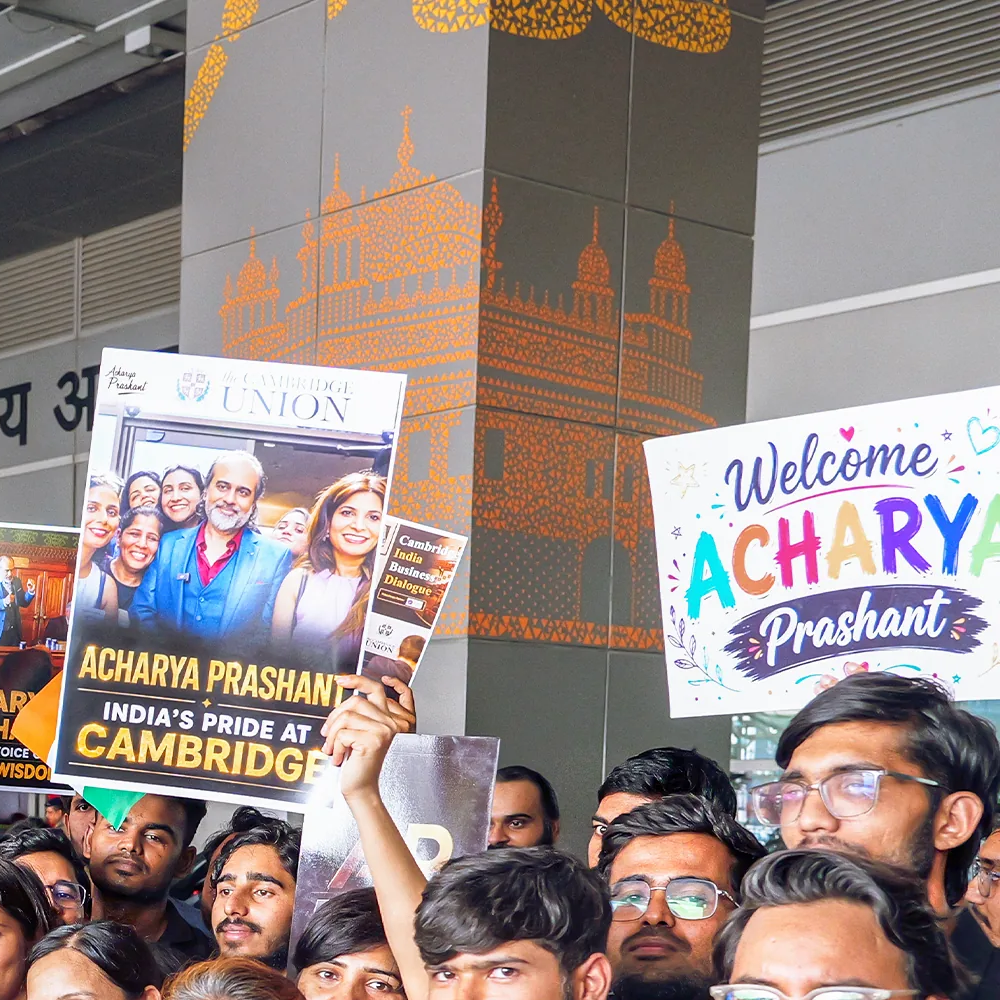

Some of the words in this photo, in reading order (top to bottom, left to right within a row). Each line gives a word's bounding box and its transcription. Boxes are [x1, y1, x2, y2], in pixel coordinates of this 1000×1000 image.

[108, 377, 149, 392] Prashant
[244, 372, 354, 395] CAMBRIDGE
[223, 386, 351, 423] UNION
[724, 432, 939, 512] Welcome
[393, 547, 423, 564] India
[399, 535, 449, 555] Cambrid
[383, 574, 432, 596] Dialogue
[388, 561, 436, 582] Business
[758, 589, 951, 667] Prashant
[78, 645, 200, 692] ACHARYA
[206, 659, 345, 707] PRASHANT
[103, 701, 195, 730] INDIA’S
[201, 712, 275, 740] PRIDE
[280, 722, 312, 744] AT
[77, 723, 330, 785] CAMBRIDGE
